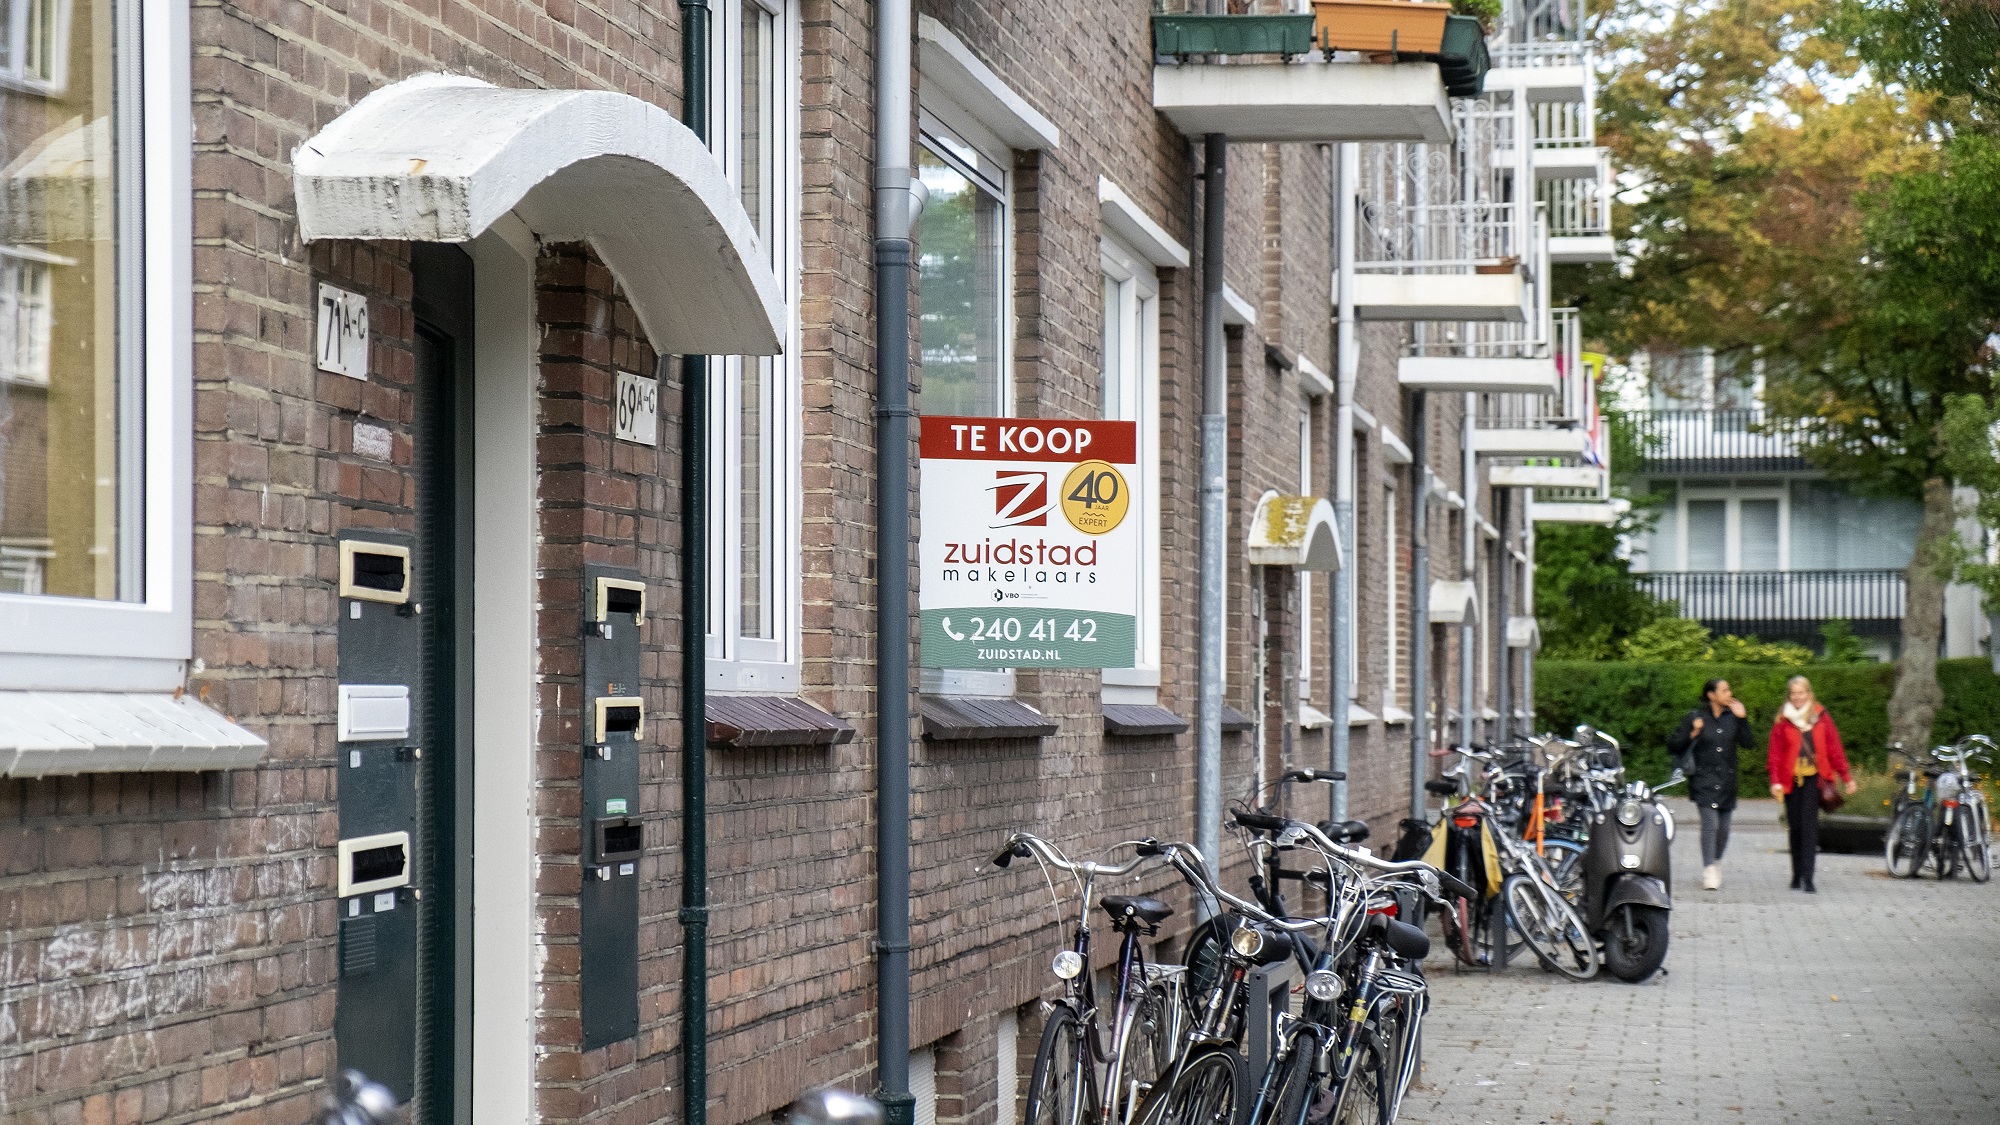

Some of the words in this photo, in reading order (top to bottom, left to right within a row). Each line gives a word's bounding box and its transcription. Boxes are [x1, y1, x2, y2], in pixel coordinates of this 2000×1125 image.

[951, 424, 986, 452] TE
[999, 426, 1092, 454] KOOP
[1067, 469, 1119, 509] 40
[1078, 517, 1107, 528] EXPERT
[943, 537, 1097, 566] zuidstad
[943, 567, 1096, 583] makelaars
[970, 617, 1021, 642] 240
[1028, 619, 1055, 642] 41
[1063, 618, 1097, 642] 42
[977, 648, 1062, 661] ZUIDSTAD.NL
